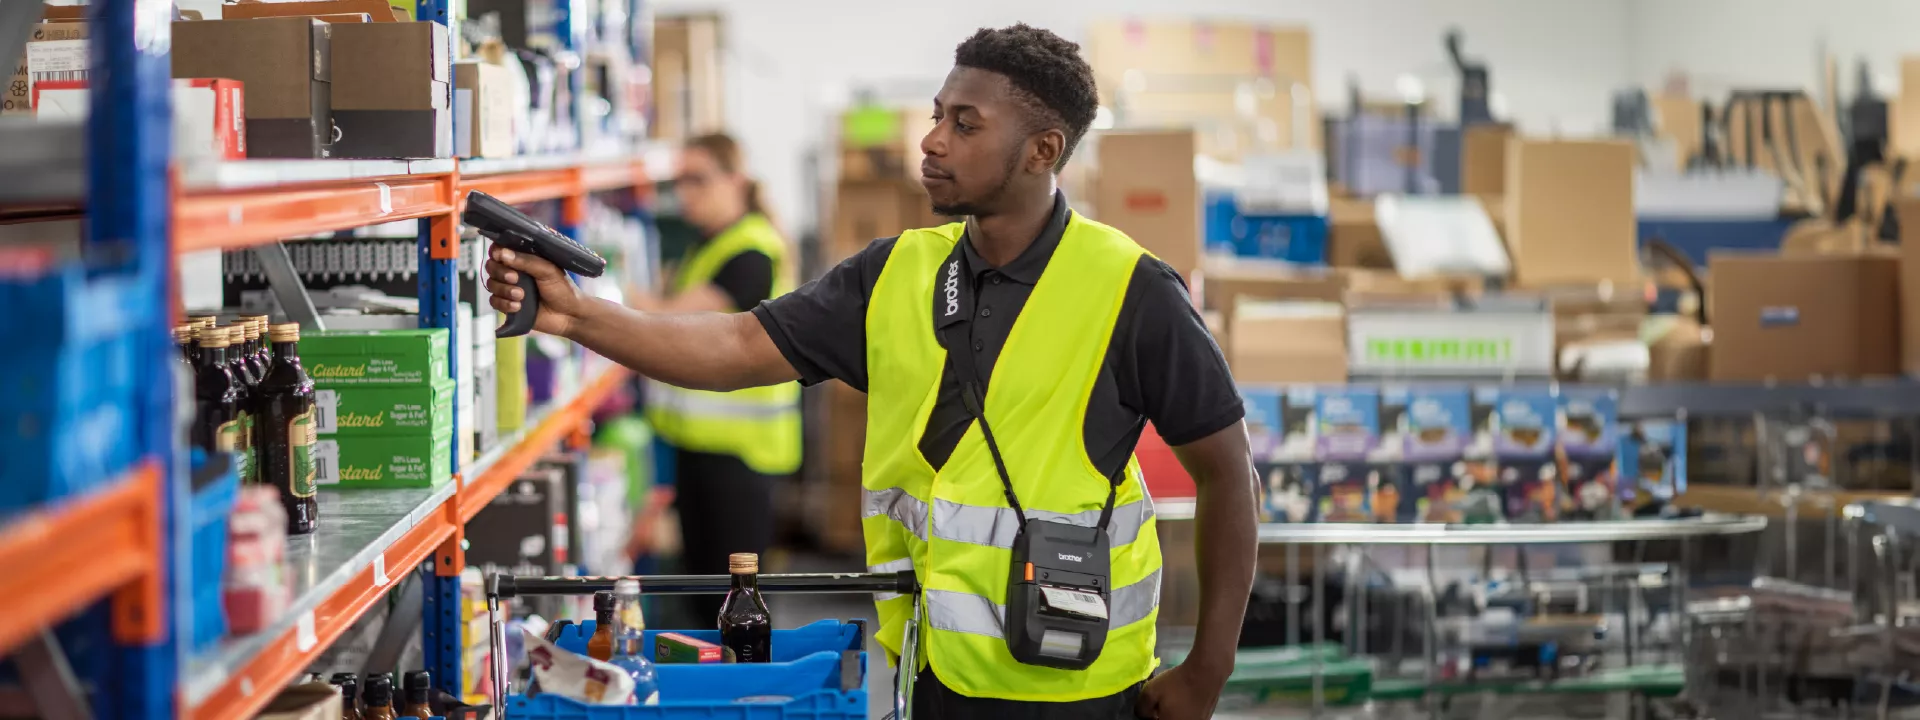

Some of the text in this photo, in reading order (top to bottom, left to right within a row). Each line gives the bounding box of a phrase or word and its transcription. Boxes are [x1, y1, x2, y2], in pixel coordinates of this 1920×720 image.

[944, 260, 958, 316] brother
[313, 363, 366, 377] Custard
[337, 411, 384, 427] stard
[339, 464, 383, 480] stard
[1058, 553, 1082, 562] brother
